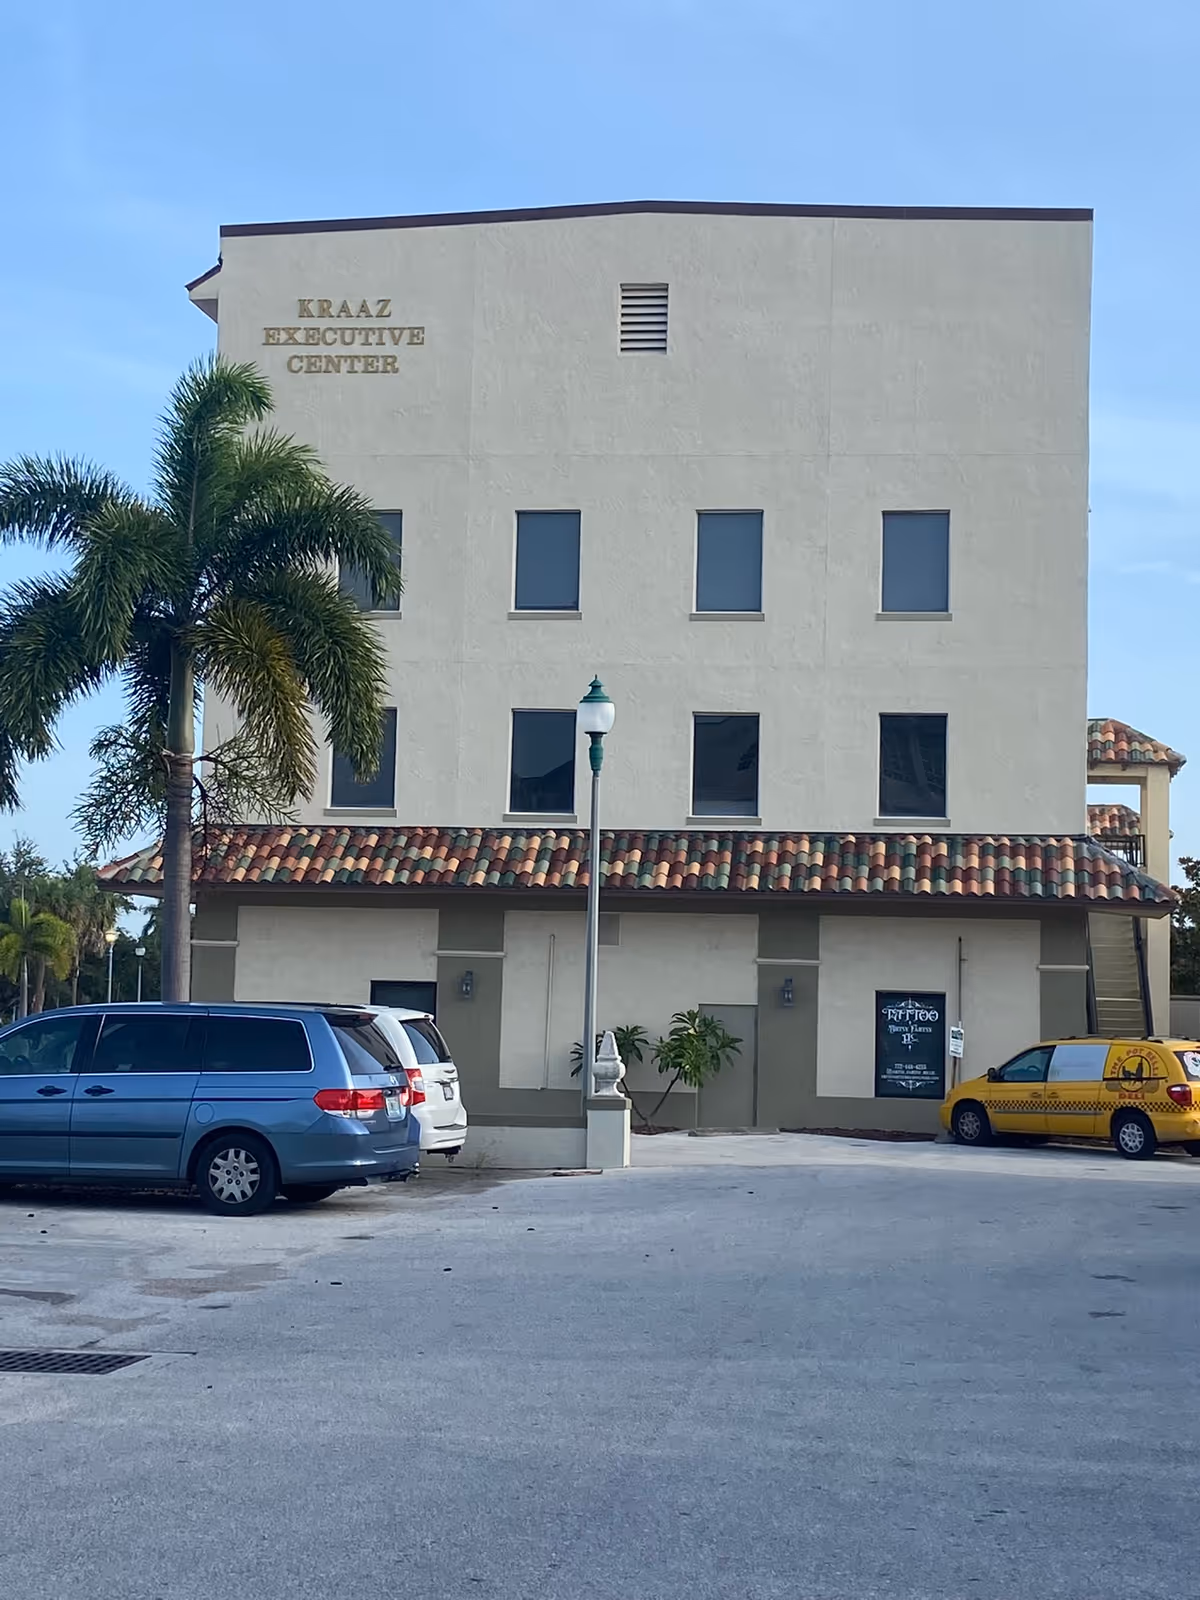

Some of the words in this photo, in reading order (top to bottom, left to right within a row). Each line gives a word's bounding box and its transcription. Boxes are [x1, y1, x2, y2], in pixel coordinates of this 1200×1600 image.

[297, 299, 392, 318] KRAAZ
[262, 326, 425, 346] EXECUTIVE
[286, 354, 399, 374] CENTER
[882, 1008, 939, 1022] TATTOO
[1110, 1055, 1124, 1076] THE
[1126, 1047, 1145, 1057] POT
[1118, 1091, 1145, 1101] DELI
